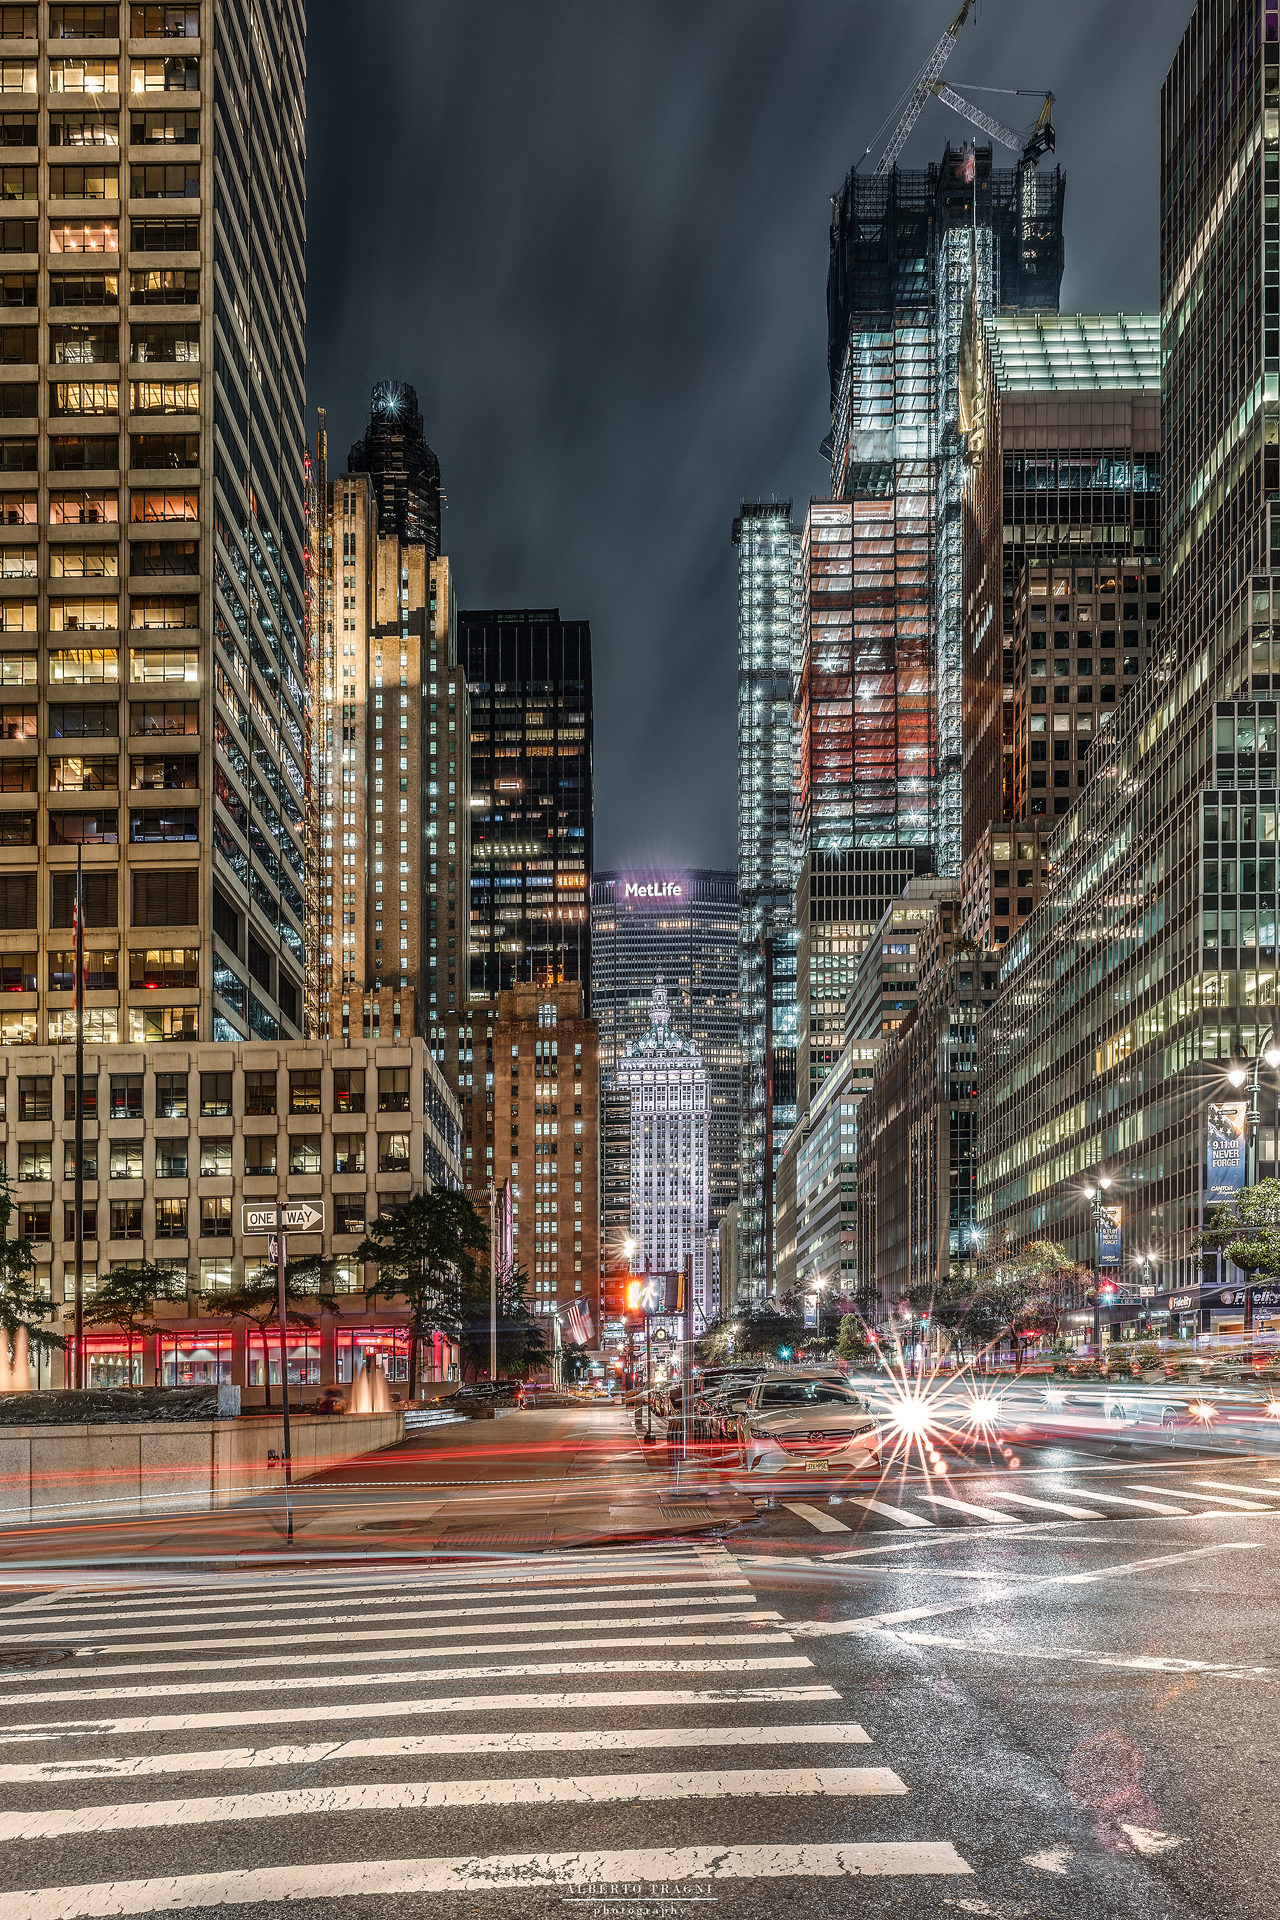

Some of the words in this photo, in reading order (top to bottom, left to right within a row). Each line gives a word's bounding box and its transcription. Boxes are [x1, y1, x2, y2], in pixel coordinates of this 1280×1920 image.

[625, 882, 682, 897] MetLife
[1212, 1140, 1239, 1150] 9.11.01
[1212, 1149, 1239, 1159] NEVER
[1212, 1158, 1240, 1168] FORGET
[250, 1212, 274, 1225] ONE
[287, 1211, 313, 1223] WAY
[1174, 1296, 1192, 1308] Fidelity
[1234, 1291, 1280, 1304] Fielity
